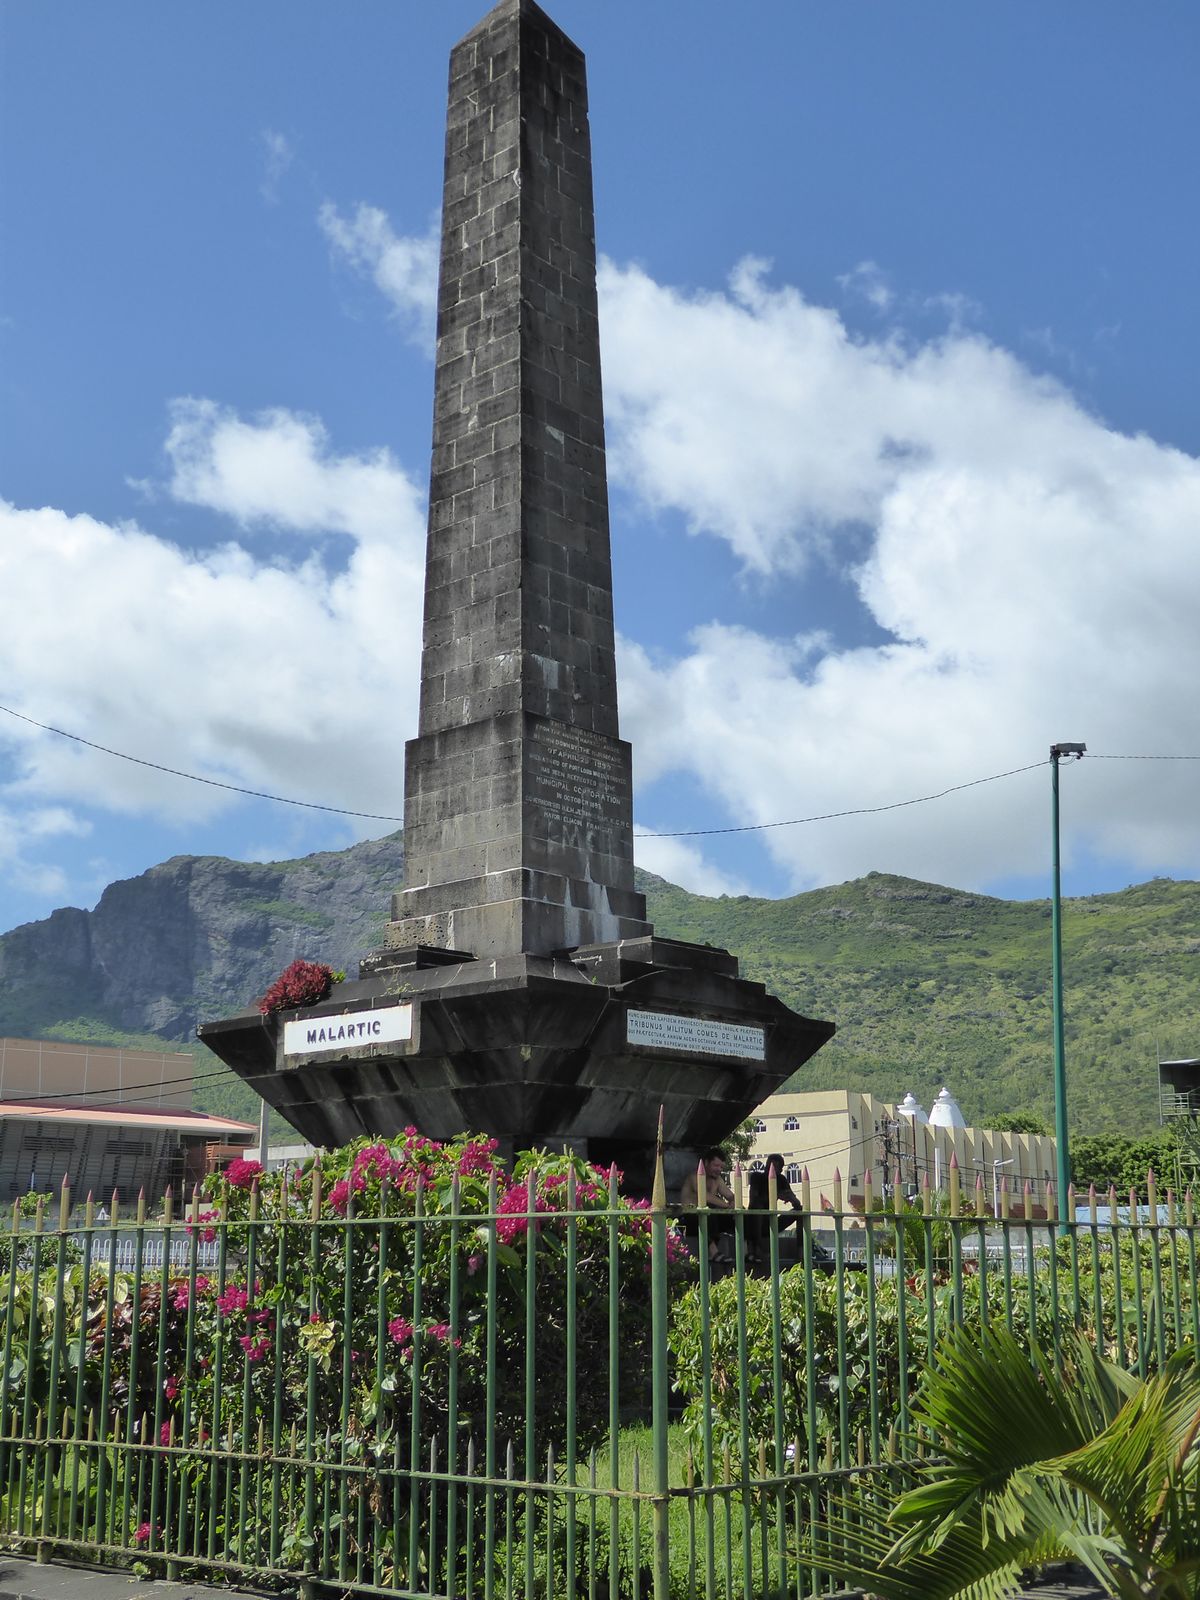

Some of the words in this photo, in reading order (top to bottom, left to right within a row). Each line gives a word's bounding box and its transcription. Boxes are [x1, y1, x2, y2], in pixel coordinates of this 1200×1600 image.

[536, 776, 570, 792] MUNICIPAL
[573, 786, 621, 805] CORPORATION
[307, 1021, 381, 1044] MALARTIC
[630, 1019, 663, 1030] TRIBUNUS
[666, 1025, 693, 1035] MILITUM
[696, 1029, 718, 1038] COMES
[733, 1034, 762, 1045] MALARTIC
